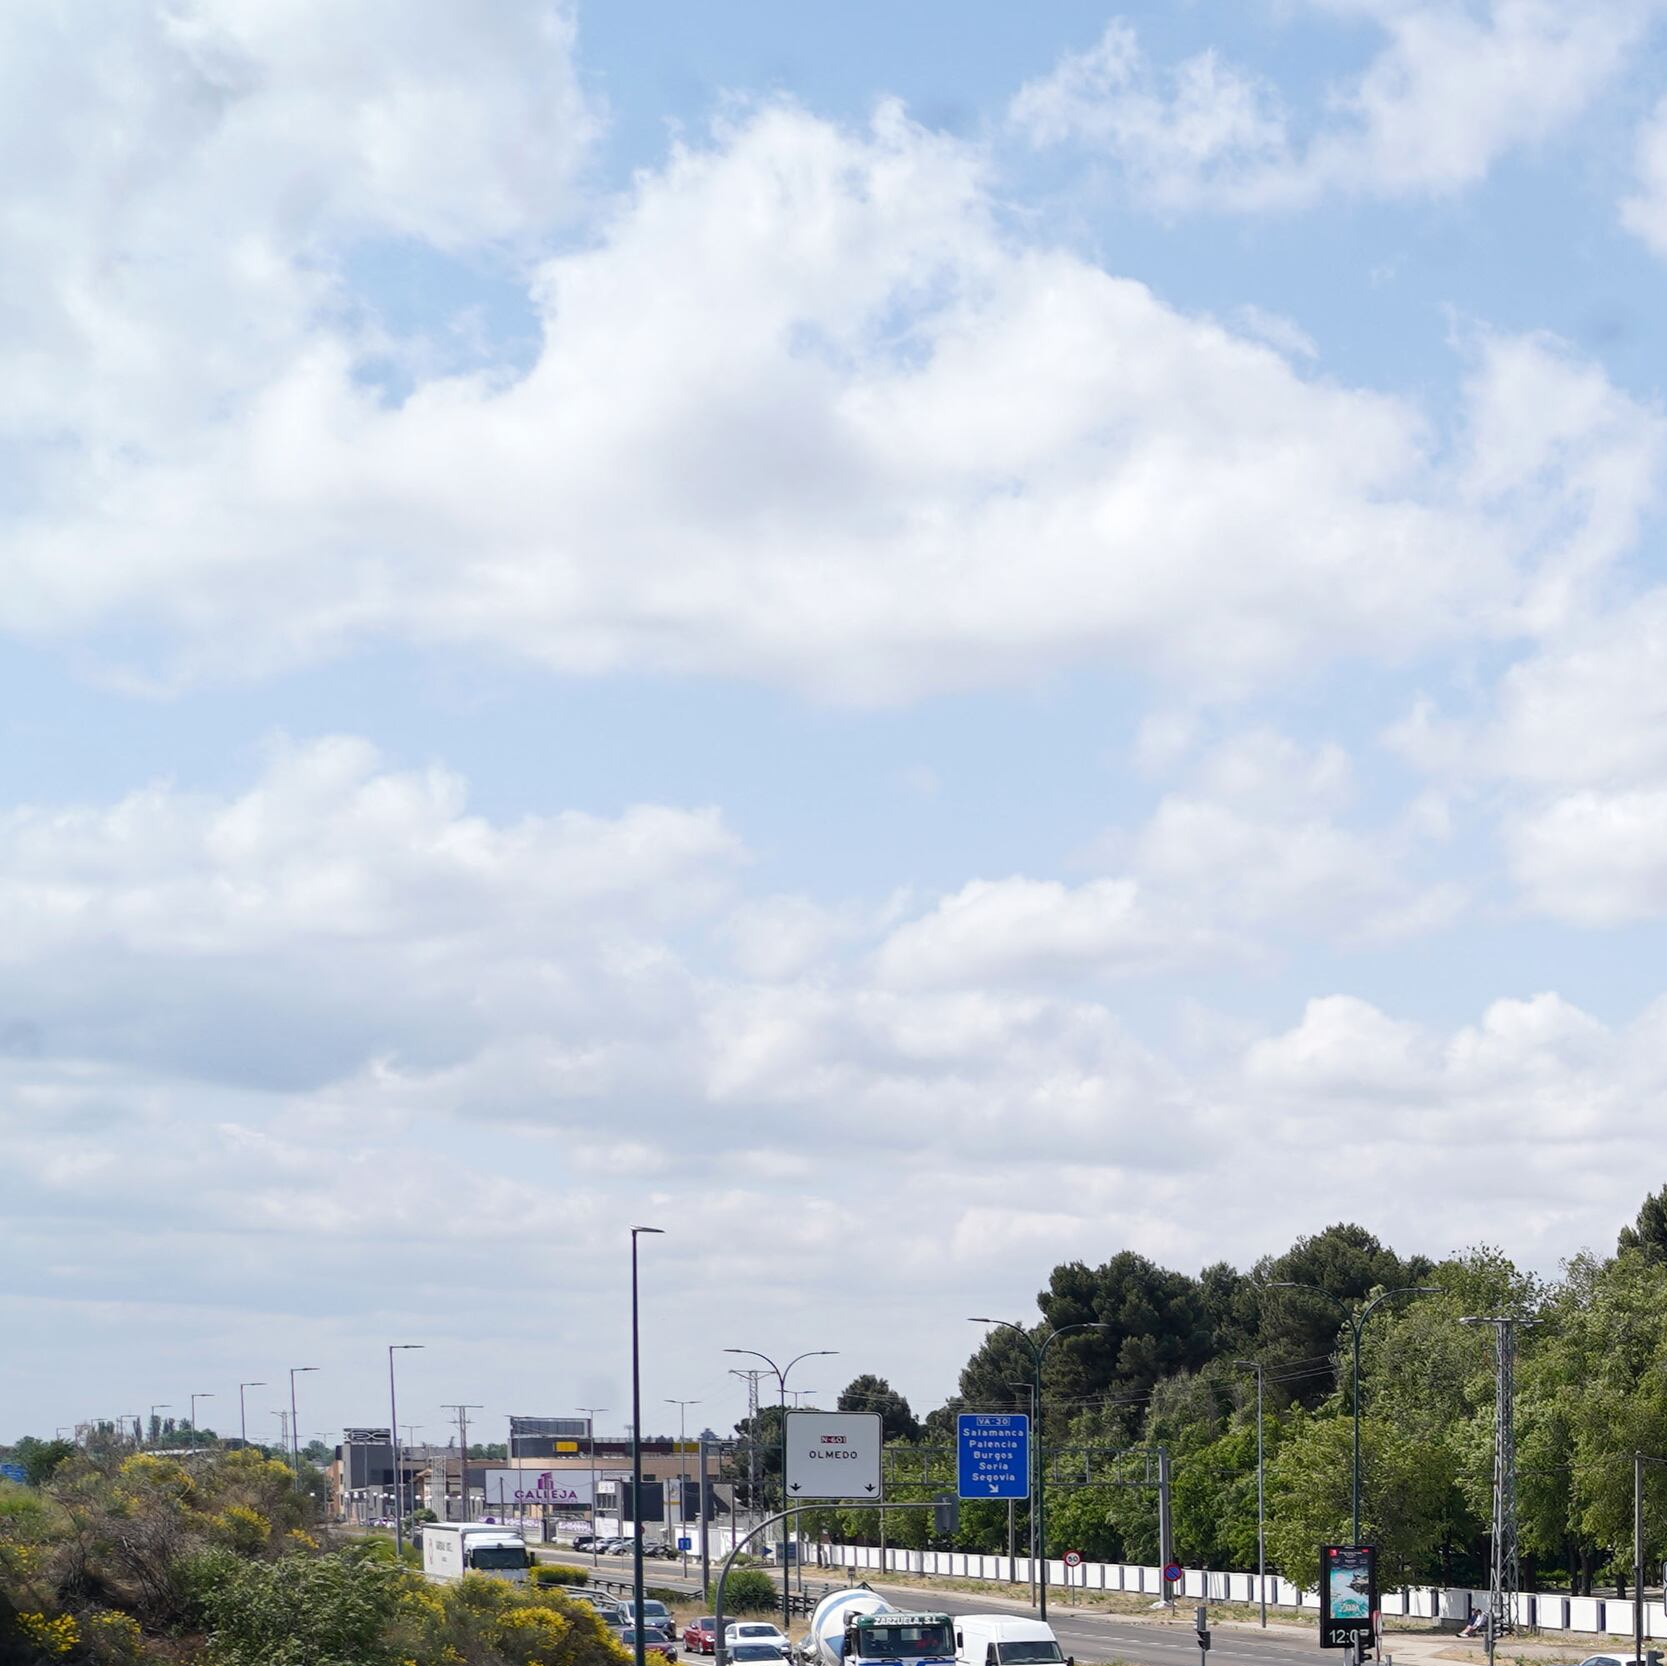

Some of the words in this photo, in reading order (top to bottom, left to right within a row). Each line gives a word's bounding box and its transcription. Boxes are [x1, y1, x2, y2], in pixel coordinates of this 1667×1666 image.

[962, 1428, 1024, 1437] Salamanca
[969, 1440, 1018, 1448] Palencia
[809, 1450, 858, 1459] OLMEDO
[973, 1451, 1013, 1461] Burgos
[978, 1462, 1009, 1470] Soria
[972, 1472, 1016, 1482] Segovia
